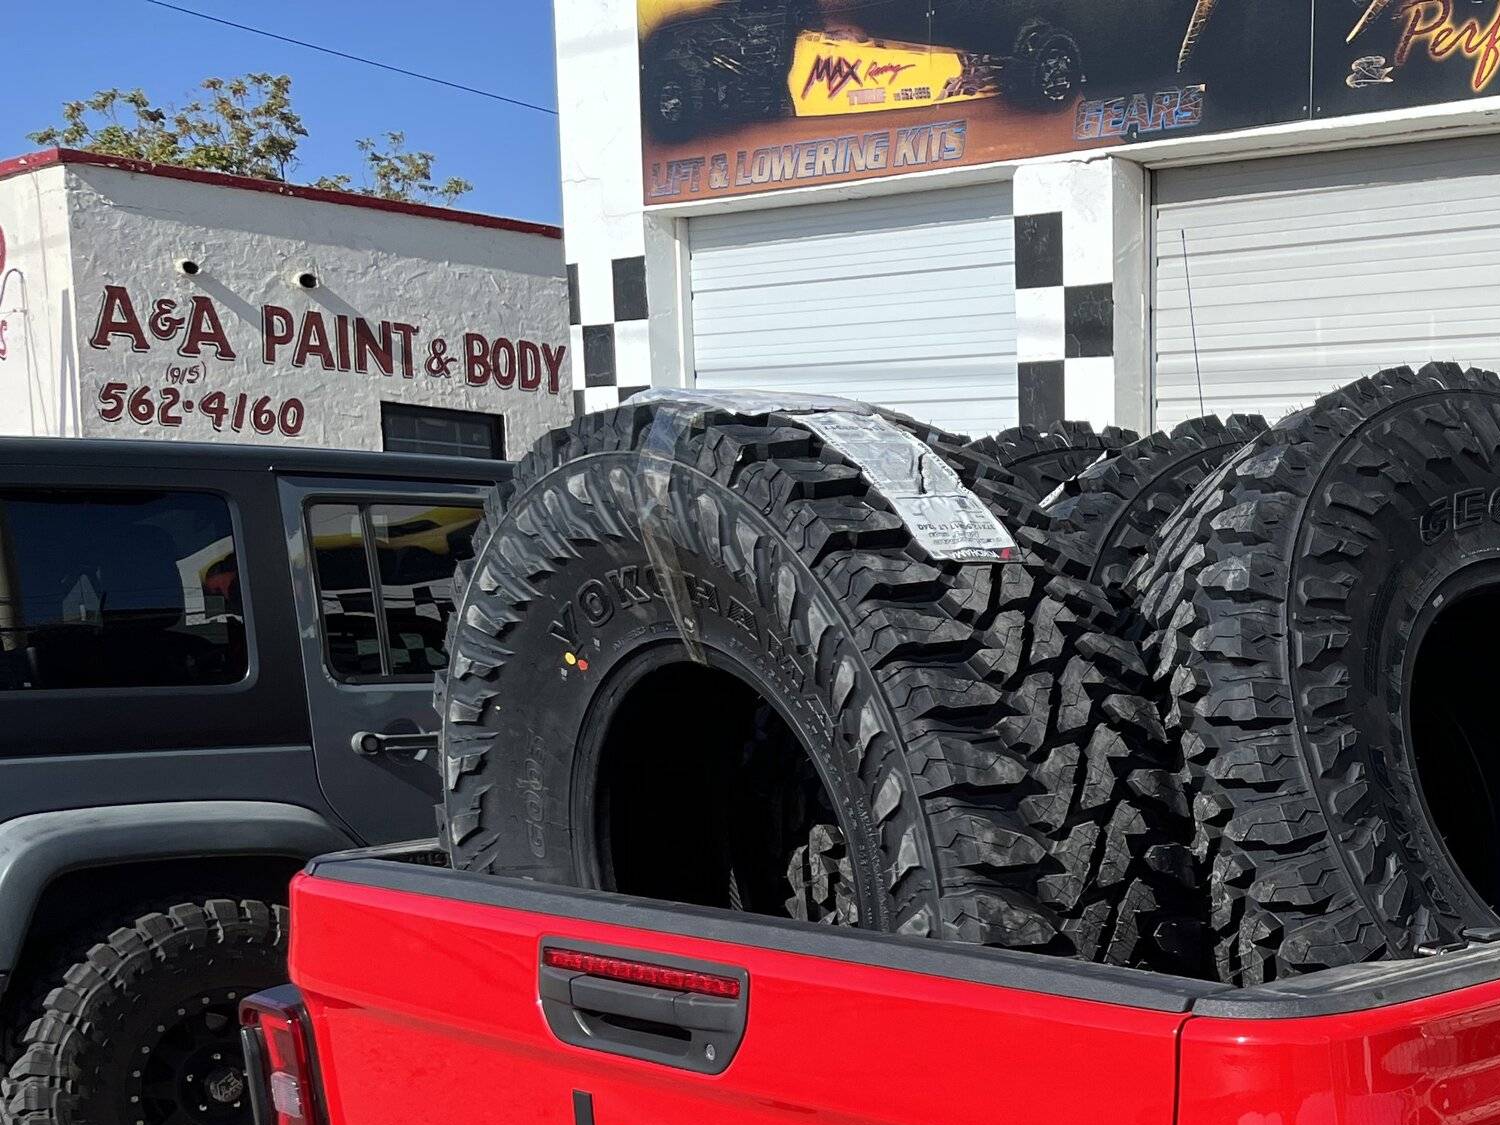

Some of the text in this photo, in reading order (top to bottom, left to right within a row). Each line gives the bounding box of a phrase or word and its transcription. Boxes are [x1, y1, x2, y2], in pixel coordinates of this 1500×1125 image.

[800, 54, 863, 101] MAX
[1073, 85, 1206, 140] GEARS
[650, 119, 969, 197] LIFT & LOWERING KITS
[262, 303, 420, 379] PAINT
[425, 338, 457, 379] &
[465, 331, 567, 395] BODY
[952, 548, 1000, 559] YOKOHAMA
[550, 562, 836, 748] YOKOHAMA
